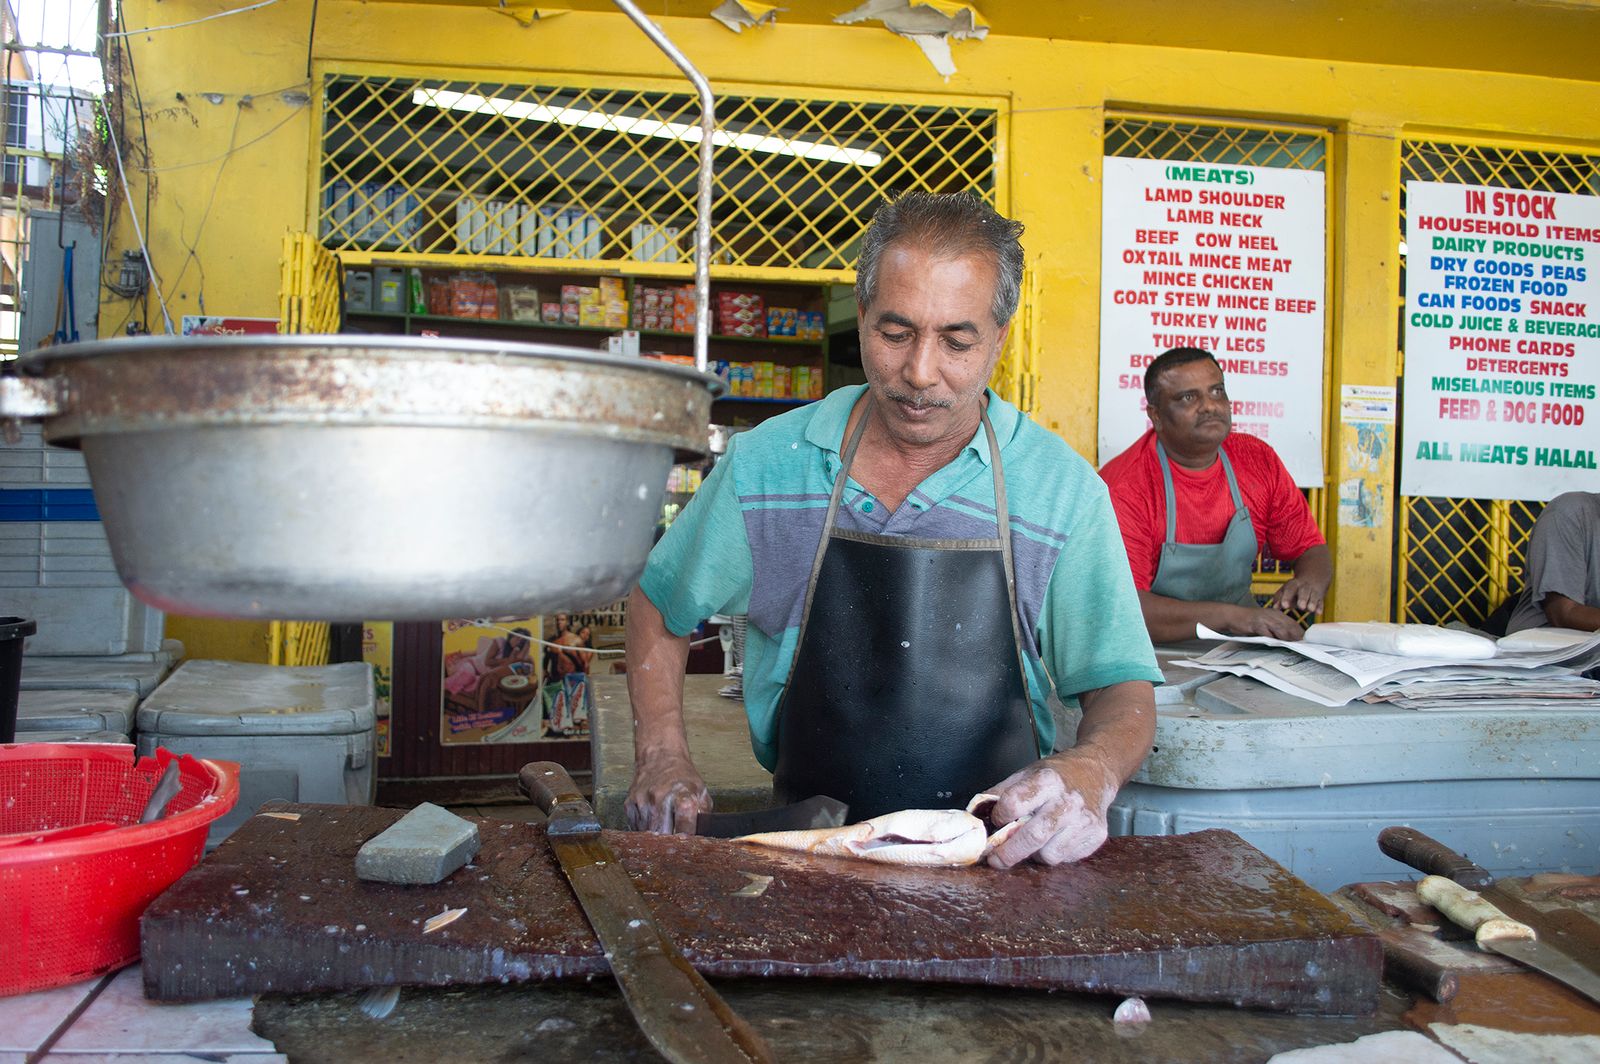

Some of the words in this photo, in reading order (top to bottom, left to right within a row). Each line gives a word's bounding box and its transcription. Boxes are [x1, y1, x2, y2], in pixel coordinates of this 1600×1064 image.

[1165, 166, 1255, 186] (MEATS)
[1198, 189, 1286, 210] SHOULDER
[1465, 190, 1487, 215] IN
[1493, 192, 1557, 220] STOCK
[1166, 208, 1214, 225] LAMB
[1220, 212, 1263, 228] NECK
[1135, 229, 1179, 245] BEEF
[1195, 233, 1233, 248] COW
[1238, 235, 1279, 251] HEEL
[1418, 216, 1540, 238] HOUSEHOLD
[1545, 226, 1600, 243] ITEMS
[1432, 236, 1487, 254] DAIRY
[1493, 240, 1585, 262] PRODUCTS
[1189, 253, 1241, 270] MINCE
[1246, 256, 1293, 273] MEAT
[1430, 256, 1468, 273] DRY
[1473, 259, 1535, 278] GOODS
[1541, 264, 1588, 283] PEAS
[1143, 271, 1197, 288] MINCE
[1202, 274, 1274, 292] CHICKEN
[1444, 275, 1515, 294] FROZEN
[1520, 280, 1569, 298] FOOD
[1113, 289, 1159, 306] GOAT
[1164, 291, 1211, 308] STEW
[1217, 295, 1269, 312] MINCE
[1275, 298, 1317, 315] BEEF
[1417, 292, 1456, 309] CAN
[1461, 295, 1522, 314] FOODS
[1530, 300, 1588, 318] SNACK
[1151, 311, 1219, 329] TURKEY
[1224, 316, 1267, 333] WING
[1410, 312, 1454, 329] COLD
[1459, 315, 1504, 332] JUICE
[1507, 318, 1519, 333] &
[1152, 333, 1220, 351] TURKEY
[1226, 337, 1266, 353] LEGS
[1449, 335, 1512, 353] PHONE
[1516, 339, 1576, 358] CARDS
[1218, 359, 1289, 376] ONELESS
[1466, 357, 1569, 378] DETERGENTS
[1431, 376, 1546, 396] MISELANEOUS
[1550, 382, 1597, 400] ITEMS
[1438, 397, 1481, 420] FEED
[1486, 399, 1497, 422] &
[1503, 400, 1537, 424] DOG
[1541, 403, 1585, 426] FOOD
[1415, 440, 1453, 461] ALL
[1459, 443, 1529, 466] MEATS
[1534, 447, 1598, 470] HALAL
